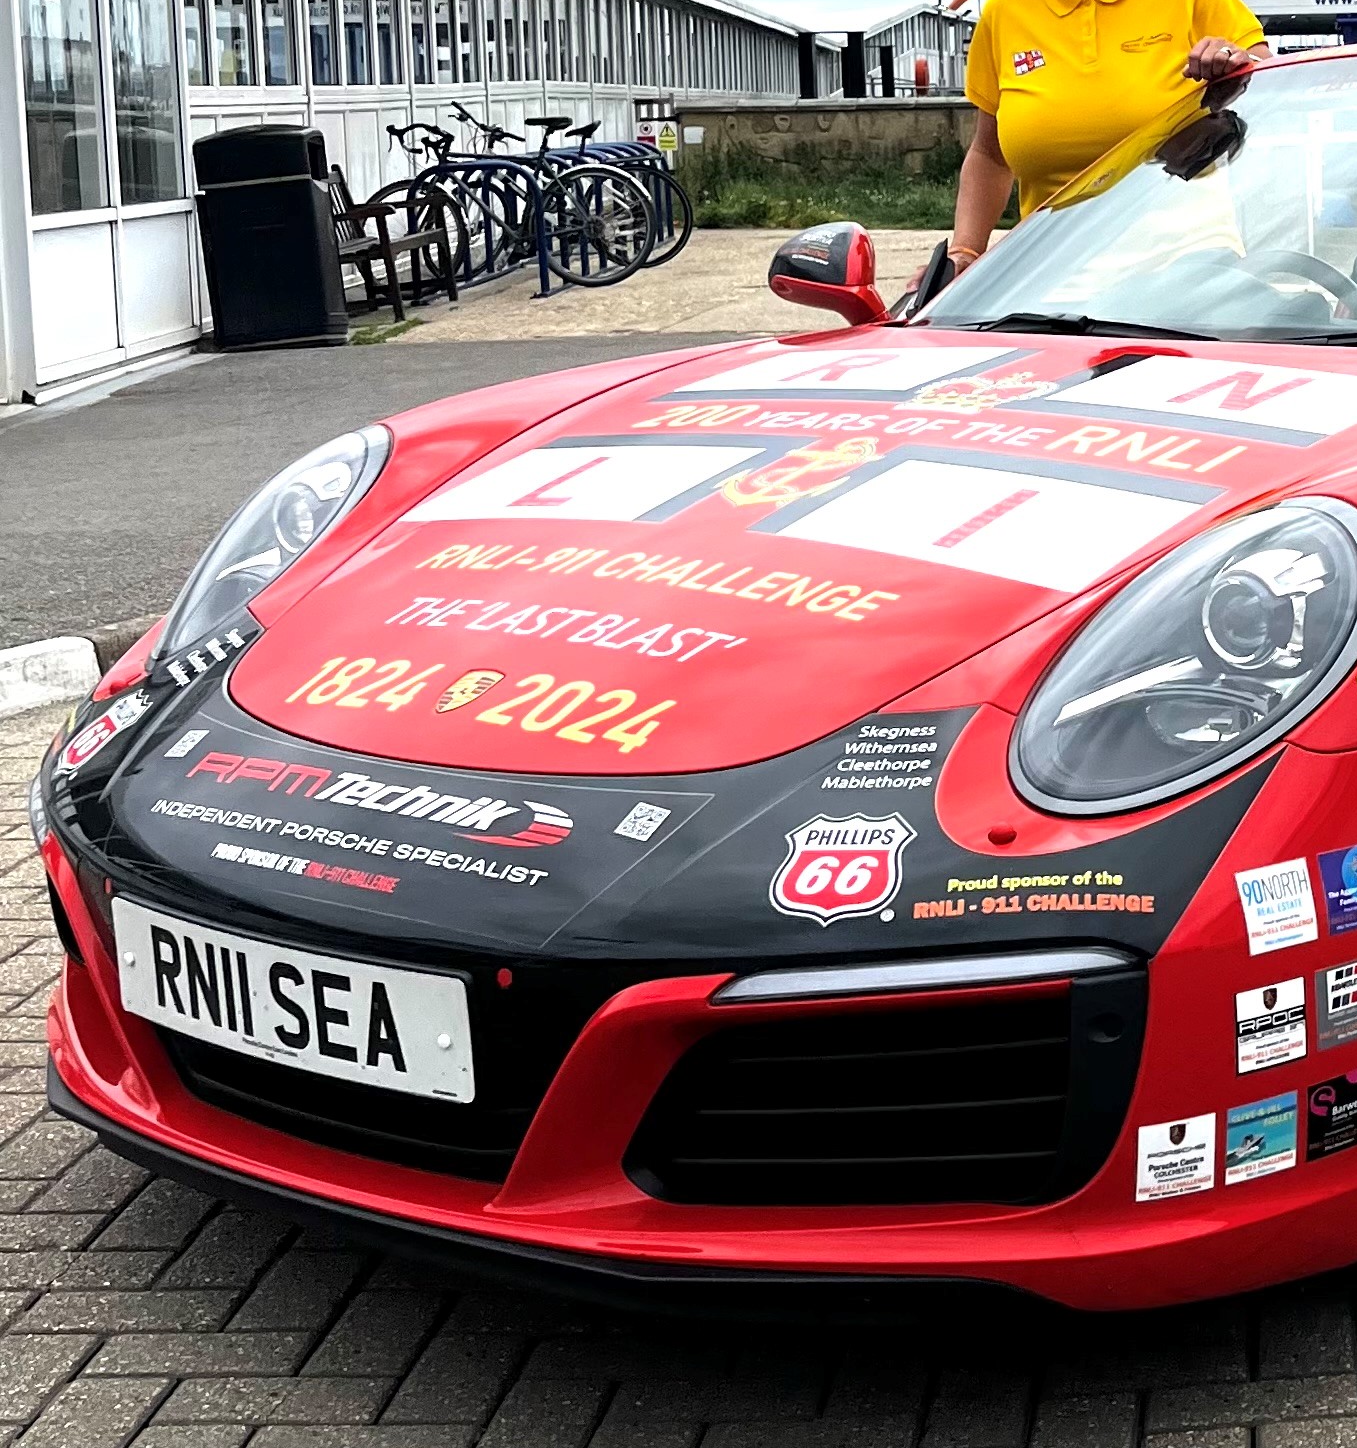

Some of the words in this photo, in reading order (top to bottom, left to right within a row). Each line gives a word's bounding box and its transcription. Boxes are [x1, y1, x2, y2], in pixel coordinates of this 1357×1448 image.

[777, 353, 900, 382] R
[1166, 370, 1318, 411] N
[631, 404, 760, 428] 200
[743, 411, 889, 431] YEARS
[883, 417, 960, 436] OF
[952, 421, 1057, 447] THE
[1043, 425, 1249, 473] RNLI
[505, 456, 611, 507] L
[414, 544, 610, 575] RNLI-911
[593, 551, 902, 622] CHALLENGE
[384, 596, 485, 627] THE
[284, 656, 447, 712] 1824
[474, 672, 678, 754] 2024
[858, 724, 937, 739] Skegness
[844, 739, 938, 755] Withernsea
[837, 756, 931, 773] Cleethorpe
[821, 773, 933, 790] Mablethorpe
[150, 799, 283, 836] INDEPENDENT
[279, 820, 402, 857] PORSCHE
[400, 843, 549, 887] SPECIALIST
[804, 827, 896, 847] PHILLIPS
[793, 854, 879, 897] 66
[946, 875, 999, 893] Proud
[1000, 873, 1068, 891] sponsor
[1071, 871, 1092, 887] of
[1093, 871, 1123, 886] the
[912, 898, 965, 919] RNLI
[981, 895, 1023, 914] 911
[1025, 893, 1155, 913] CHALLENGE
[1256, 904, 1275, 916] REAL
[1277, 897, 1302, 912] ESTATE
[268, 961, 408, 1073] SEA
[1239, 1006, 1304, 1035] RPOC
[1148, 1162, 1179, 1173] Porsche
[1179, 1156, 1205, 1167] Centre
[1153, 1164, 1199, 1179] COLCHESTER
